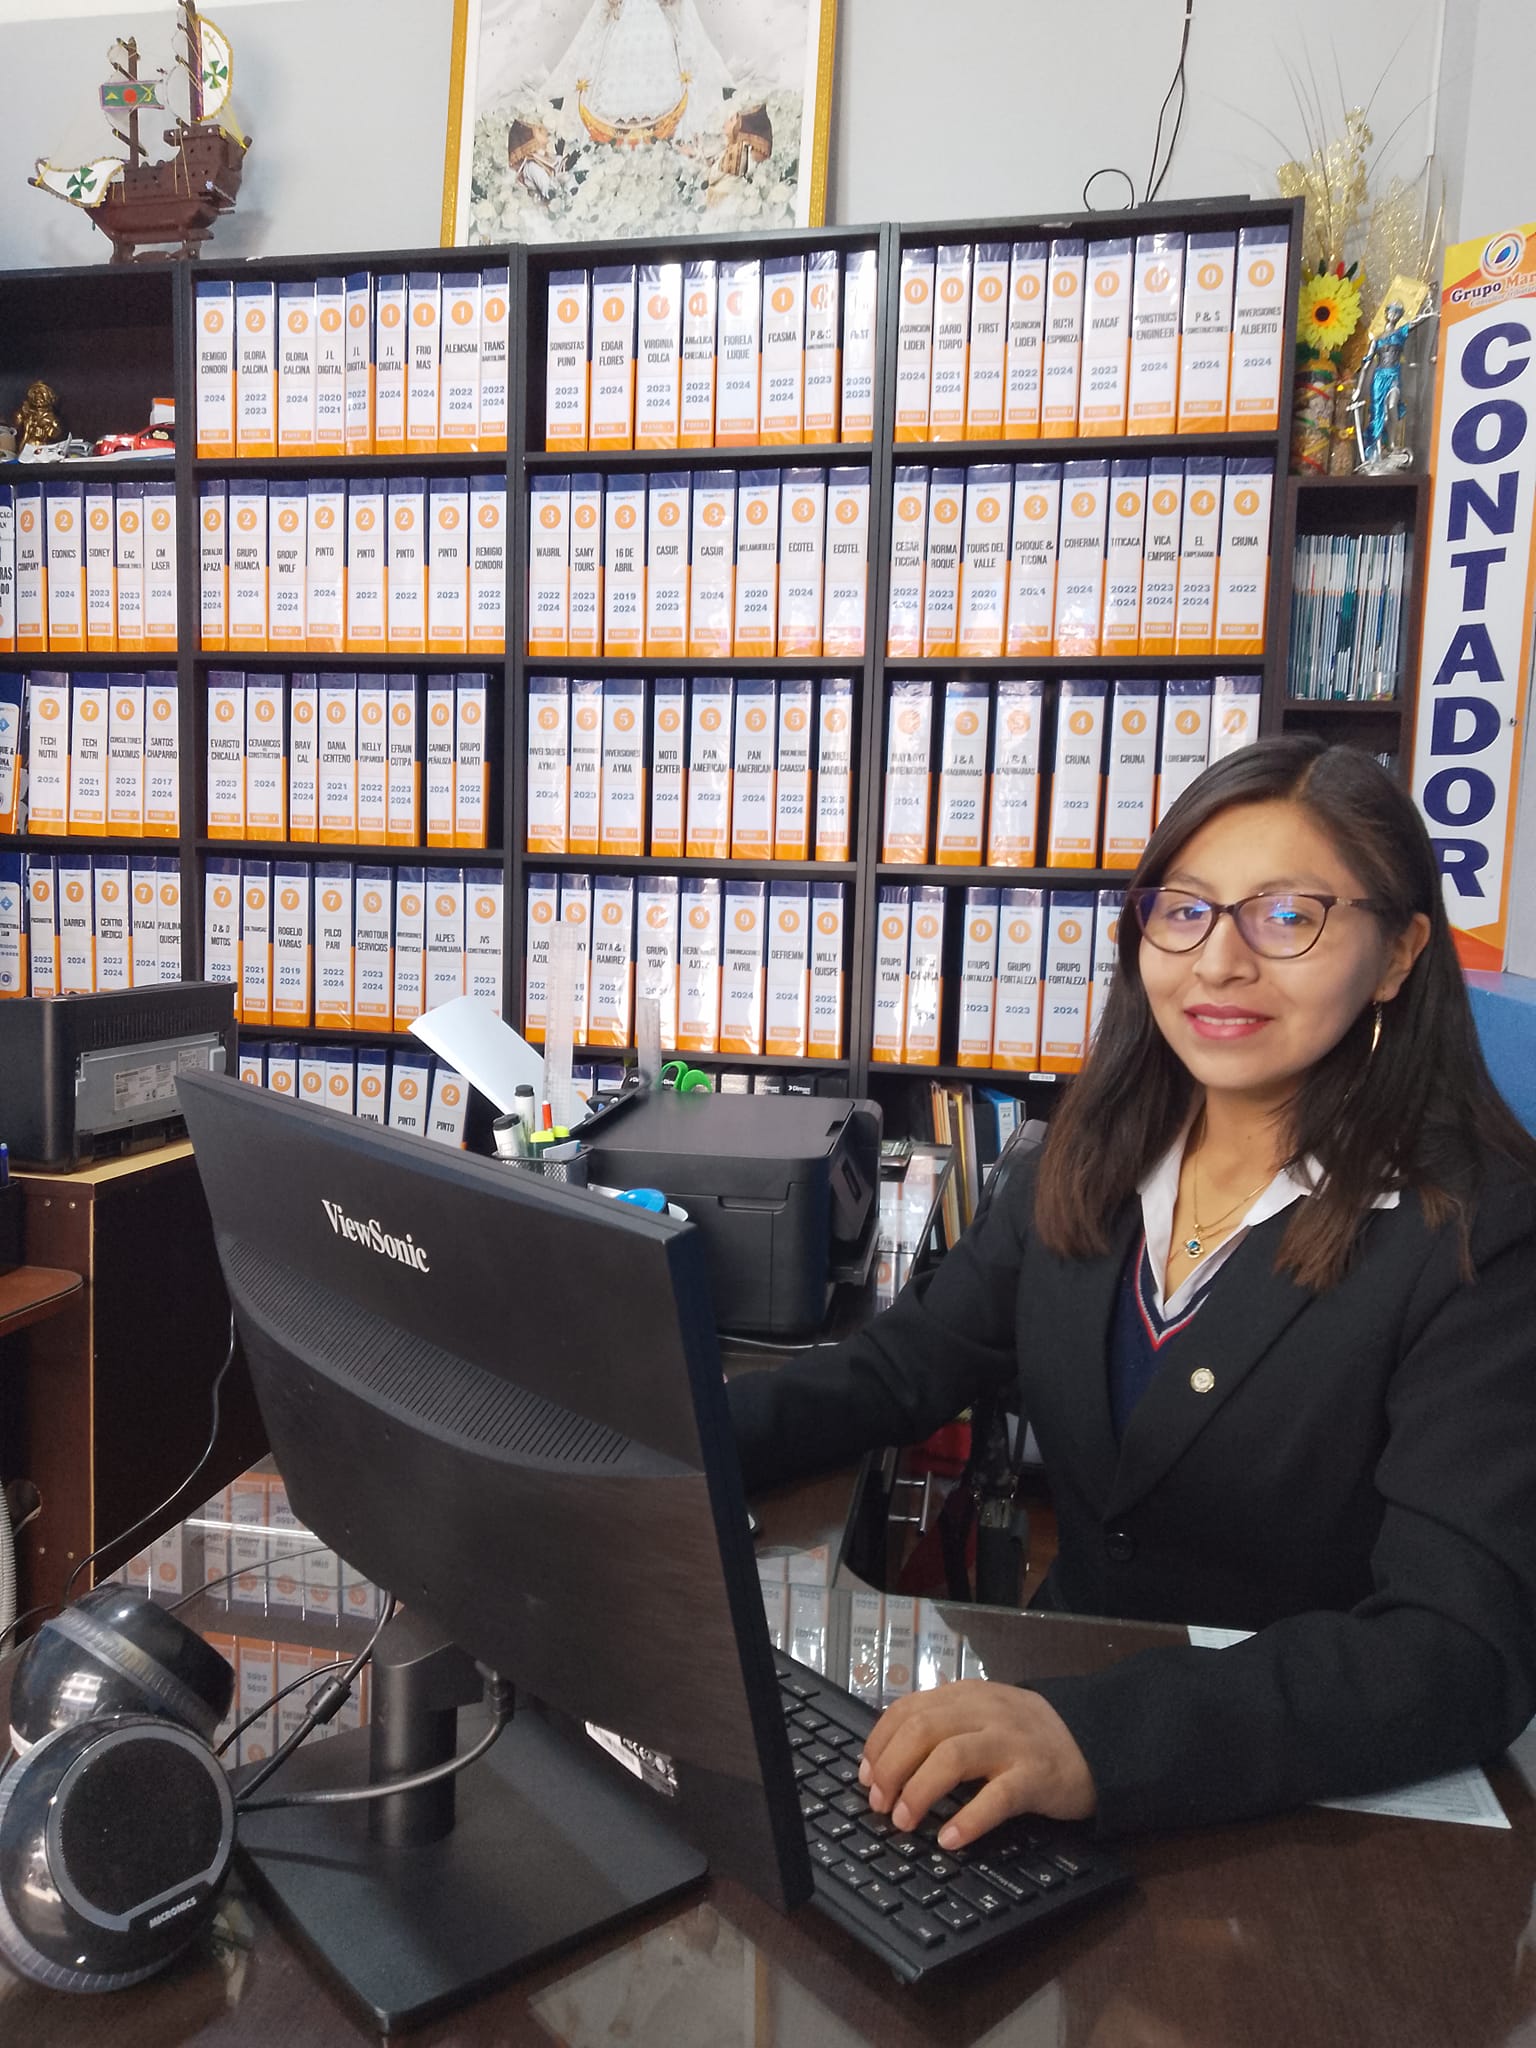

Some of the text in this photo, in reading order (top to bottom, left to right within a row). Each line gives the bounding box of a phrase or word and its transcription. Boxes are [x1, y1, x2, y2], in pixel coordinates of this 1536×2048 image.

[1451, 282, 1502, 302] Grupo
[1195, 310, 1220, 323] P & S
[978, 322, 999, 334] FIRST
[1241, 322, 1277, 335] ALBERTO
[768, 331, 796, 343] FCASMA
[1136, 327, 1174, 341] ENGINEER
[484, 341, 505, 351] TRANS
[550, 341, 584, 351] SONRISITAS
[601, 341, 623, 351] EDGAR
[644, 339, 673, 349] VIRGINIA
[903, 340, 926, 351] LIDER
[938, 339, 962, 350] TURPO
[1015, 336, 1037, 348] LIDER
[416, 345, 432, 355] FRIO
[445, 344, 478, 353] ALEMSAM
[201, 352, 228, 361] REMIGIO
[244, 351, 267, 361] GLORIA
[285, 352, 309, 362] GLORIA
[647, 353, 670, 363] COLCA
[726, 349, 750, 360] LUQUE
[416, 360, 431, 370] MAS
[557, 356, 576, 367] PUNO
[599, 355, 624, 366] FLORES
[201, 365, 228, 375] CONDORI
[242, 365, 269, 375] CALCINA
[283, 365, 311, 375] CALCINA
[317, 365, 343, 375] DIGITAL
[379, 361, 403, 371] DIGITAL
[1141, 362, 1168, 372] 2024
[1011, 369, 1038, 379] 2022
[769, 378, 794, 387] 2022
[449, 388, 473, 396] 2022
[555, 387, 579, 396] 2023
[600, 386, 624, 394] 2024
[204, 394, 226, 402] 2024
[244, 407, 267, 415] 2023
[318, 406, 341, 414] 2021
[1015, 540, 1054, 551] CHOQUE &
[1064, 537, 1100, 548] COHERMA
[1153, 536, 1171, 546] VICA
[1194, 536, 1204, 547] EL
[1231, 536, 1258, 547] CRUNA
[315, 547, 334, 557] PINTO
[475, 546, 503, 557] REMIGIO
[656, 546, 679, 556] CASUR
[700, 546, 723, 557] CASUR
[789, 542, 814, 553] ECOTEL
[833, 543, 859, 554] ECOTEL
[931, 542, 957, 555] NORMA
[966, 542, 1005, 554] TOURS DEL
[89, 549, 110, 558] SIDNEY
[156, 549, 165, 558] CM
[236, 548, 258, 558] GRUPO
[277, 550, 297, 560] GROUP
[357, 549, 375, 559] PINTO
[396, 549, 415, 558] PINTO
[438, 548, 457, 558] PINTO
[575, 548, 594, 558] SAMY
[615, 548, 634, 558] 16 DE
[1148, 550, 1176, 562] EMPIRE
[151, 561, 170, 570] LASER
[234, 561, 260, 570] HUANCA
[931, 557, 955, 569] ROQUE
[973, 557, 996, 569] VALLE
[1021, 556, 1047, 566] TICONA
[18, 562, 39, 571] COMPANY
[203, 562, 221, 572] APAZA
[278, 564, 296, 573] WOLF
[574, 562, 595, 572] TOURS
[614, 562, 634, 573] ABRIL
[1020, 587, 1046, 596] 2024
[1229, 584, 1257, 593] 2022
[276, 592, 298, 600] 2023
[437, 591, 459, 599] 2023
[537, 592, 560, 600] 2022
[656, 590, 679, 599] 2022
[833, 590, 858, 598] 2023
[1423, 321, 1532, 898] CONTADOR
[40, 736, 56, 746] TECH
[82, 738, 98, 747] TECH
[151, 738, 174, 747] SANTOS
[210, 739, 240, 749] EVARISTO
[248, 739, 280, 748] CERAMICOS
[295, 741, 311, 750] BRAV
[327, 742, 346, 751] DANIA
[362, 742, 382, 752] NELLY
[391, 744, 412, 754] EFRAIN
[428, 743, 451, 752] CARMEN
[459, 742, 480, 752] GRUPO
[38, 750, 58, 759] NUTRI
[80, 751, 99, 760] NUTRI
[112, 750, 139, 759] MAXIMUS
[147, 751, 177, 759] CHAPARRO
[210, 752, 240, 761] CHICALLA
[297, 754, 309, 763] CAL
[322, 754, 350, 764] CENTENO
[658, 750, 677, 761] MOTO
[703, 750, 717, 760] PAN
[747, 751, 761, 761] PAN
[1120, 754, 1145, 765] CRUNA
[390, 757, 412, 766] CUTIPA
[460, 756, 480, 766] MARTI
[1065, 754, 1091, 766] CRUNA
[575, 763, 595, 773] AYMA
[613, 763, 632, 774] AYMA
[655, 764, 681, 774] CENTER
[736, 764, 771, 774] AMERICAN
[216, 780, 237, 788] 2023
[326, 782, 347, 790] 2021
[611, 793, 634, 801] 2023
[780, 794, 803, 802] 2023
[1063, 800, 1089, 810] 2023
[64, 918, 86, 928] DARREN
[100, 918, 123, 927] CENTRO
[101, 930, 122, 939] MEDICO
[278, 927, 303, 937] ROGELIO
[324, 928, 342, 938] PILCO
[357, 930, 388, 940] PUNOTOUR
[160, 935, 180, 944] QUISPE
[211, 937, 231, 946] MOTOS
[435, 933, 455, 943] ALPES
[278, 939, 302, 949] VARGAS
[325, 941, 340, 950] PARI
[357, 942, 388, 952] SERVICIOS
[532, 953, 549, 964] AZUL
[596, 954, 625, 964] RAMIREZ
[816, 952, 837, 962] WILLY
[880, 957, 901, 966] GRUPO
[161, 961, 180, 969] 2021
[279, 966, 301, 974] 2019
[733, 962, 752, 972] AVRIL
[1007, 962, 1031, 972] GRUPO
[1056, 962, 1080, 972] GRUPO
[814, 966, 838, 976] QUISPE
[434, 974, 456, 982] 2024
[881, 972, 900, 982] YOAN
[1000, 974, 1037, 985] FORTALEZA
[1048, 975, 1086, 985] FORTALEZA
[776, 992, 799, 1000] 2024
[1053, 1006, 1079, 1014] 2024
[398, 1116, 416, 1127] PINTO
[436, 1121, 455, 1133] PINTO
[322, 1199, 430, 1273] ViewSonic
